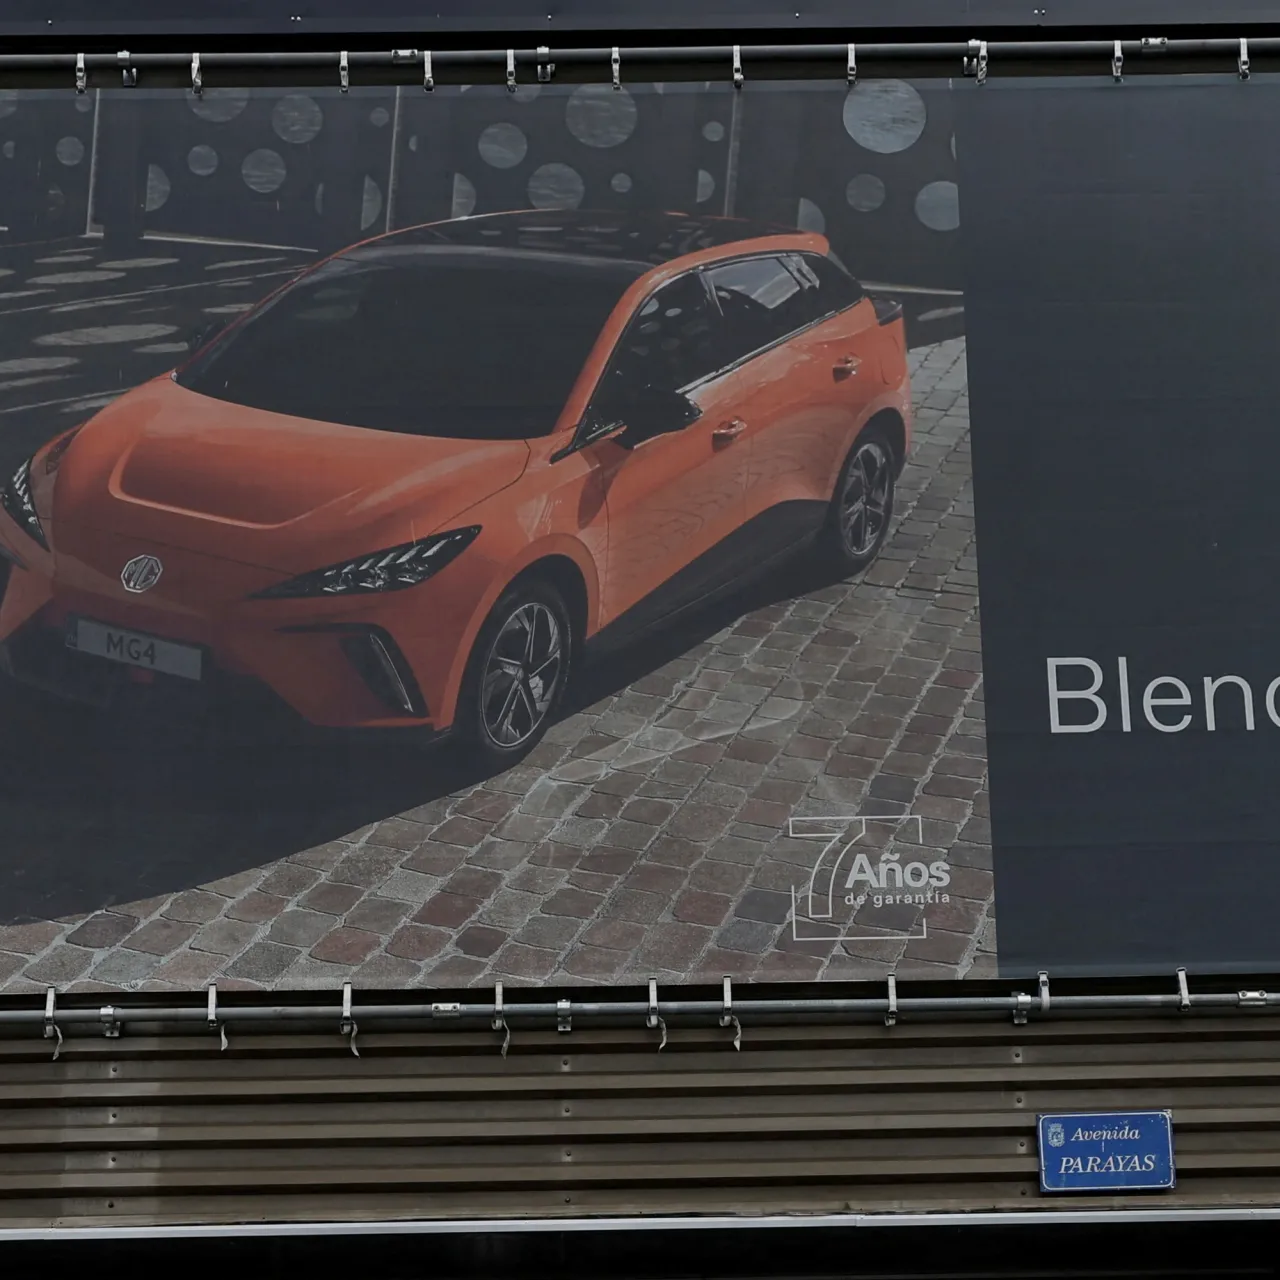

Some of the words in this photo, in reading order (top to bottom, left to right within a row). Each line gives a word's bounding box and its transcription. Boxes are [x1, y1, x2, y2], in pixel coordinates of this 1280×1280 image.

[106, 632, 157, 665] MG4
[845, 853, 951, 888] Años
[845, 893, 865, 905] de
[873, 891, 950, 908] garantía
[1070, 1126, 1141, 1141] Avenida
[1059, 1154, 1157, 1174] PARAYAS
